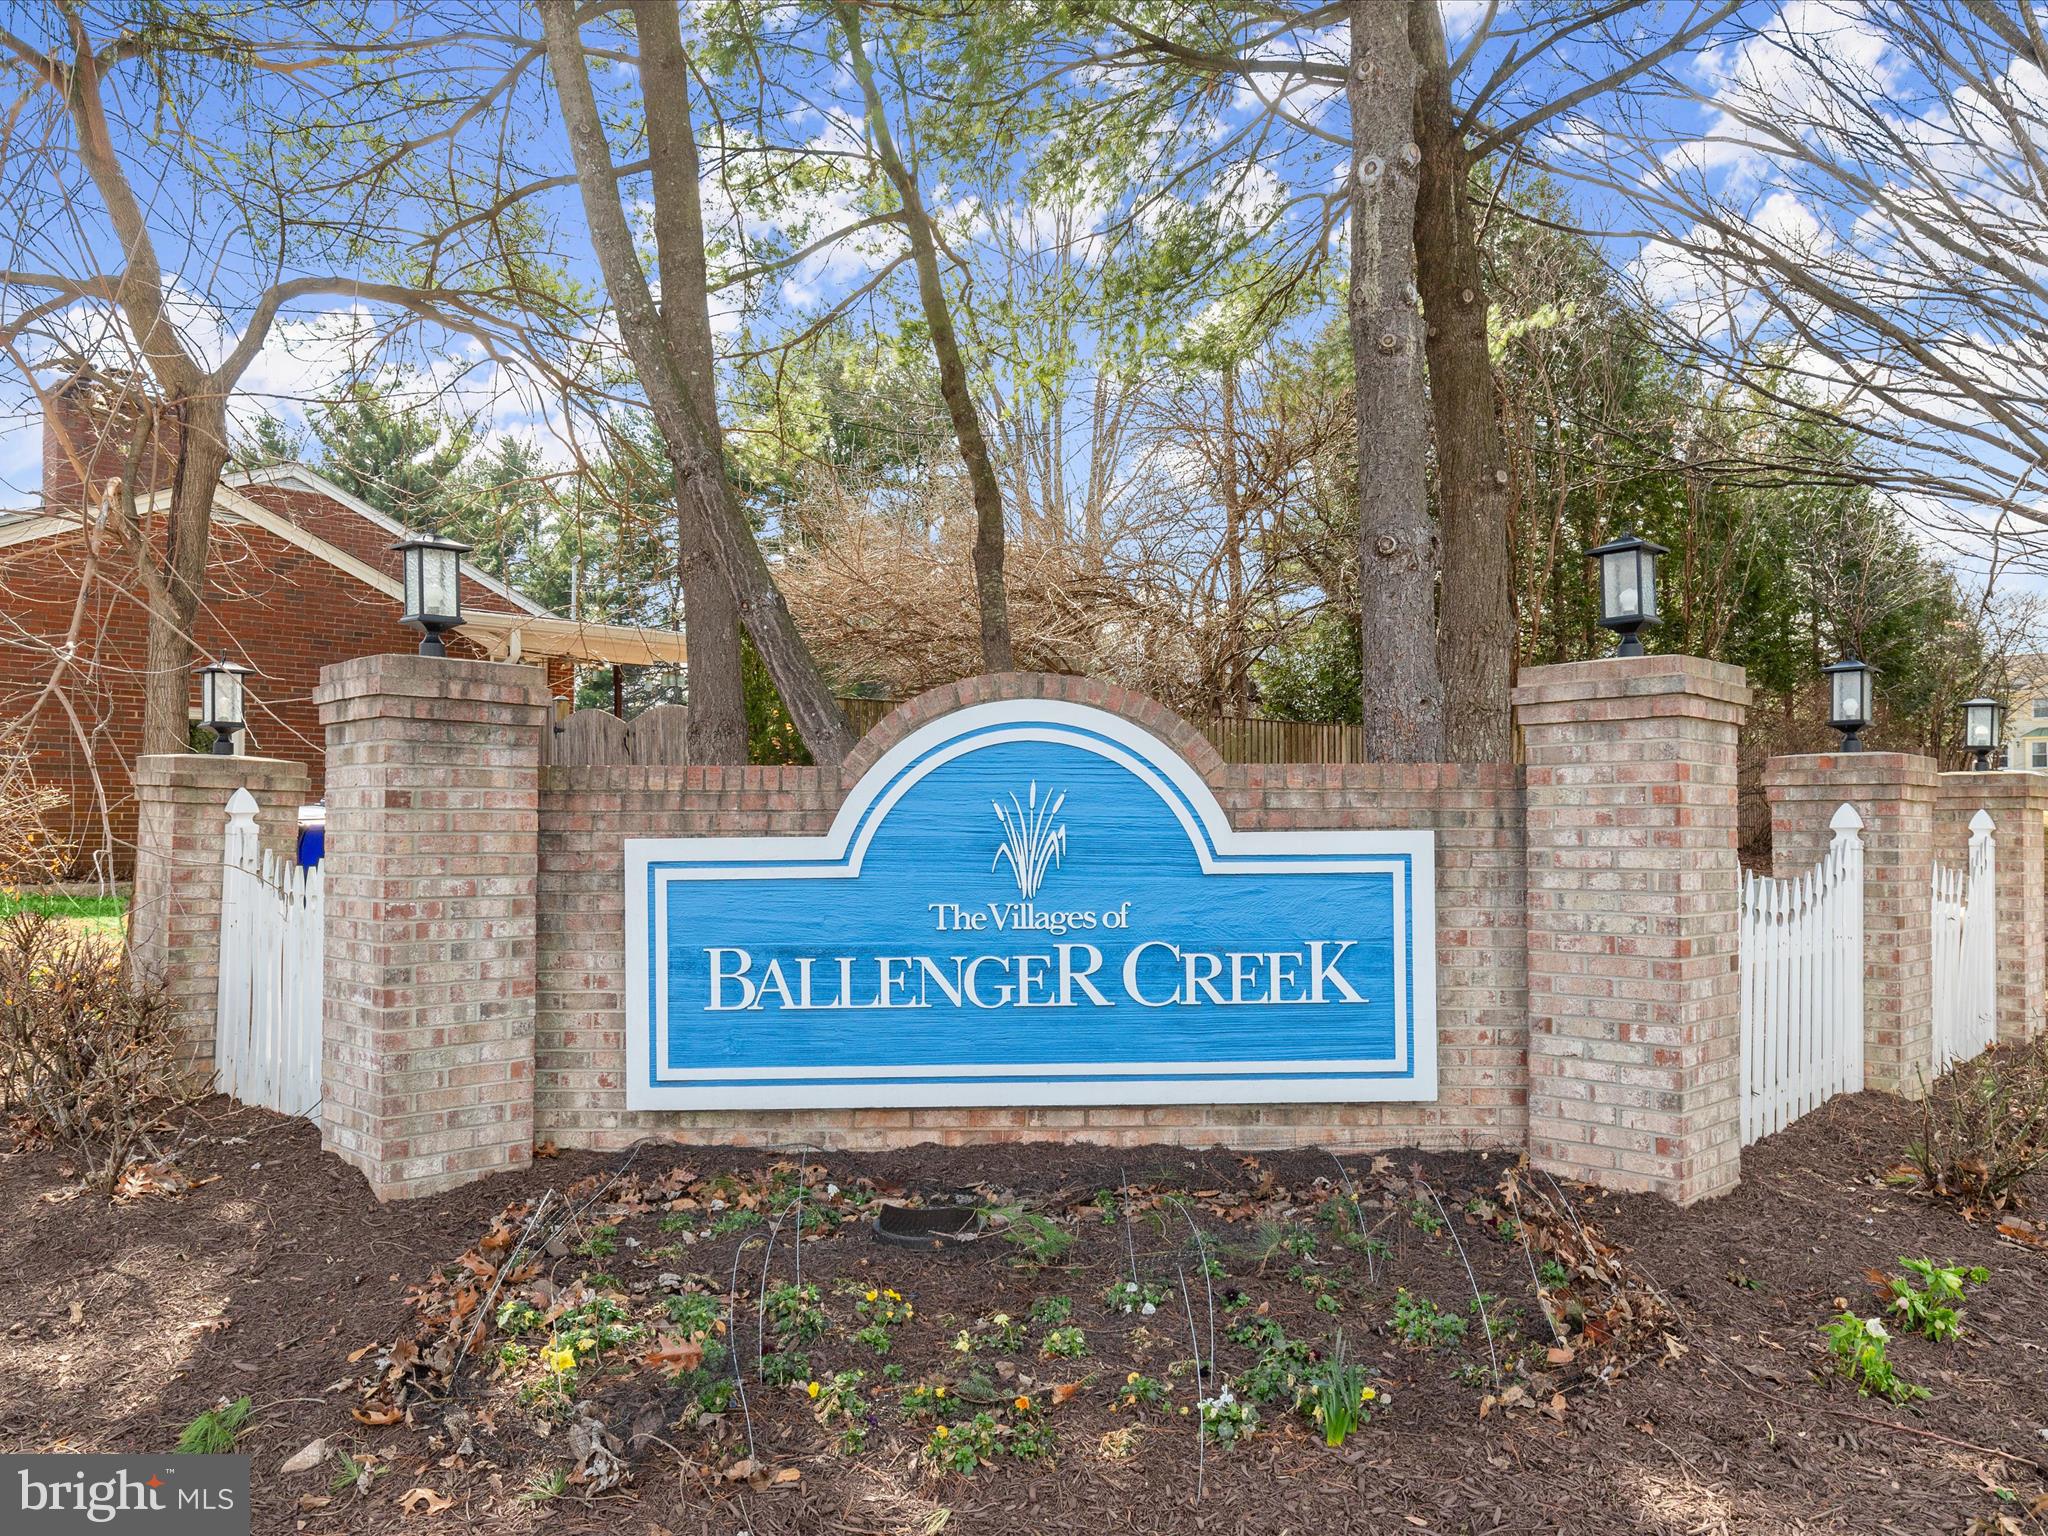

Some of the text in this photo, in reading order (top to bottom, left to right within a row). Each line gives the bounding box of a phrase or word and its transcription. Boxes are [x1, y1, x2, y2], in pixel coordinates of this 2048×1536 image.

[928, 901, 1132, 935] The Villages of
[703, 941, 1369, 1011] BALLENGER CREEK
